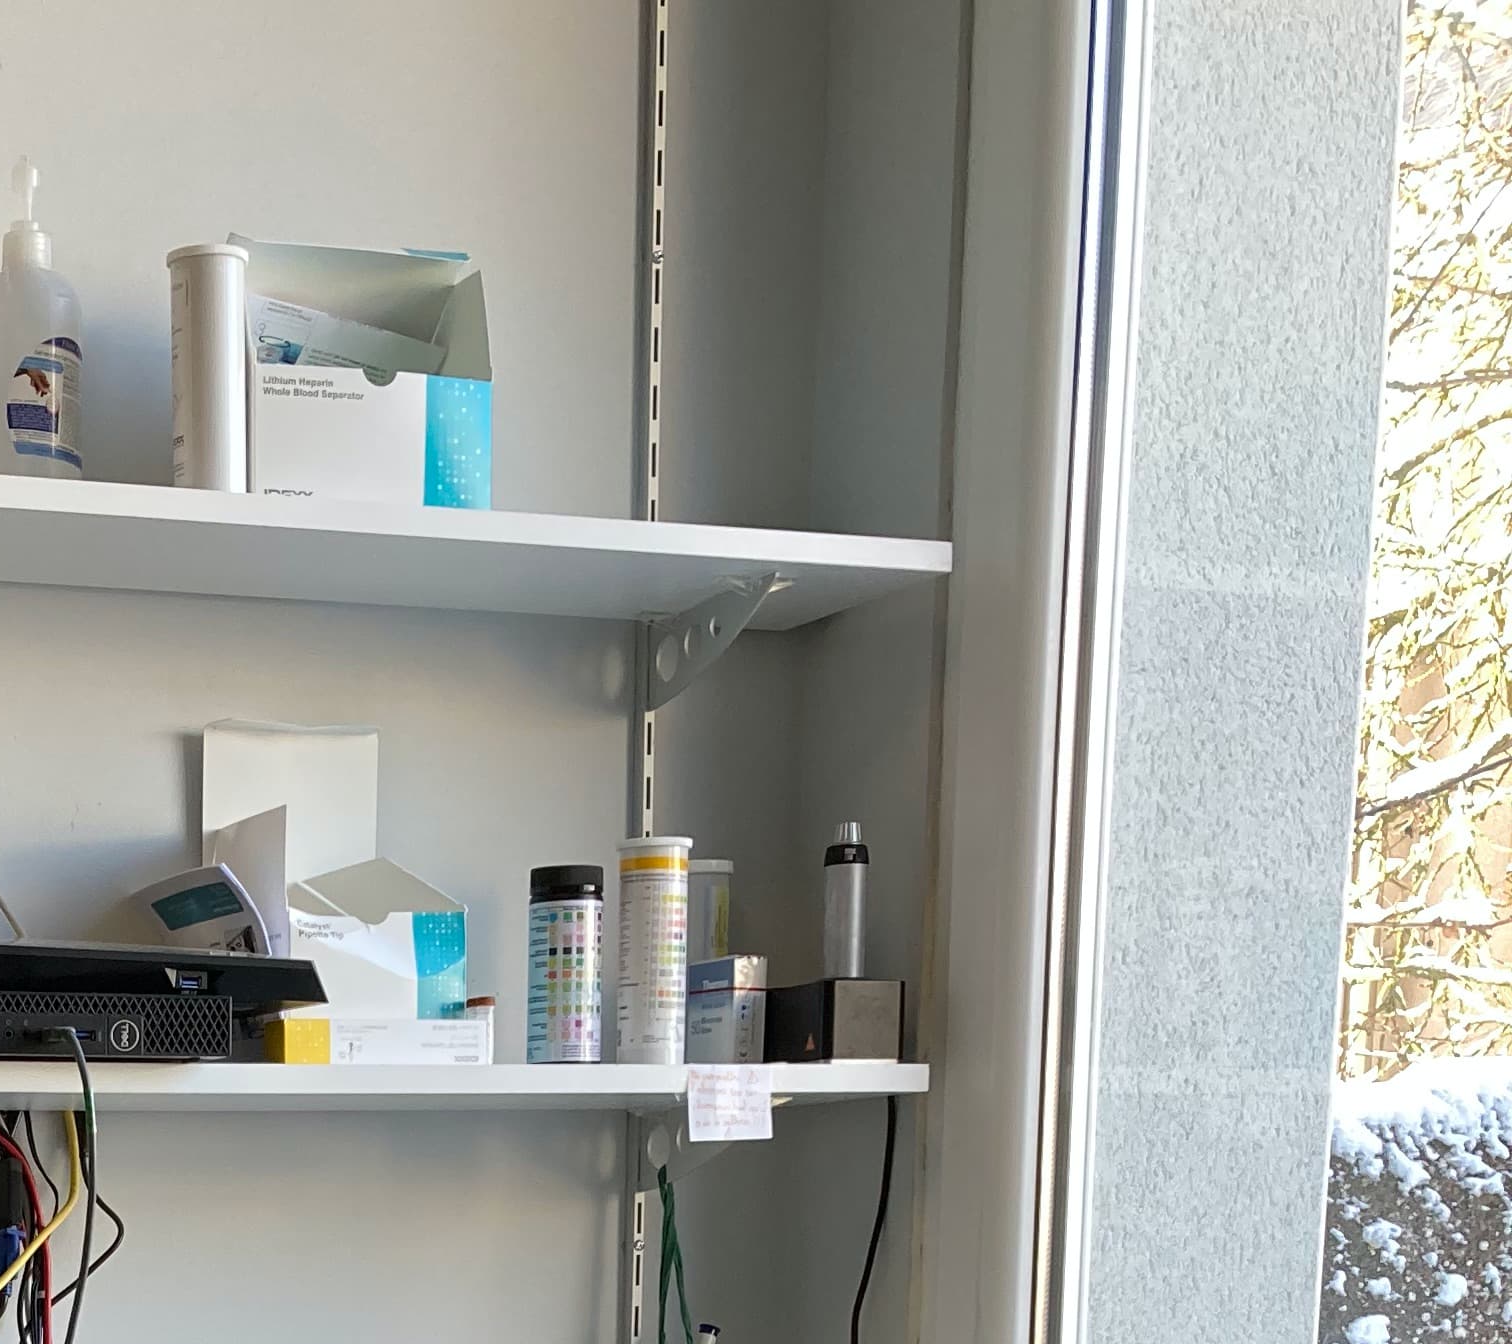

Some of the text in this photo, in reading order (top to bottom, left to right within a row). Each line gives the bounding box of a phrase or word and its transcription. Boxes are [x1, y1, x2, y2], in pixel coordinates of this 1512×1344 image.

[262, 376, 334, 388] Lithium Heparin
[262, 386, 365, 401] Whole Blood Separator
